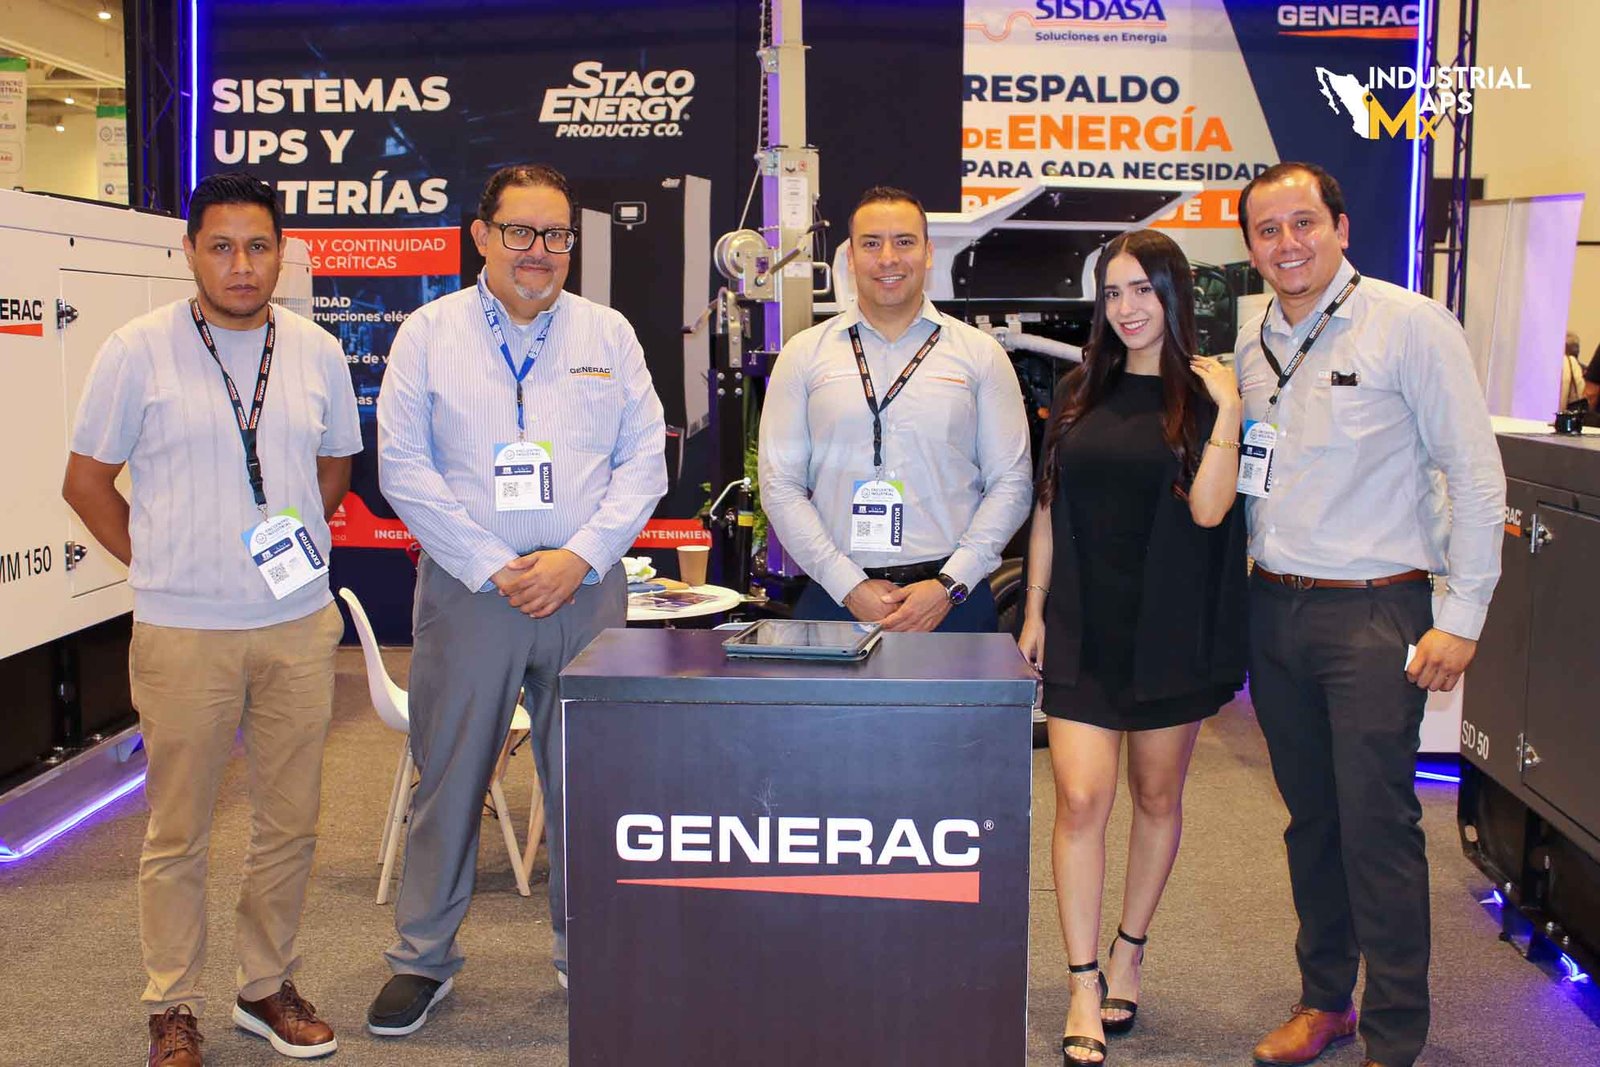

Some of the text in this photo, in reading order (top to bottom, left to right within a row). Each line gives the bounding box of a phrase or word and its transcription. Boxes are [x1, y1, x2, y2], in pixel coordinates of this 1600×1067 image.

[1277, 4, 1420, 26] GENERAC
[1035, 31, 1100, 42] Soluciones
[1103, 34, 1118, 42] en
[568, 61, 695, 98] STACO
[962, 74, 1180, 104] RESPALDO
[212, 76, 451, 114] SISTEMAS
[538, 88, 694, 122] ENERGY
[555, 123, 683, 138] PRODUCTS CO.
[962, 106, 1234, 151] DE ENERGÍA
[214, 129, 354, 164] UPS Y
[961, 160, 1033, 178] PARA
[1041, 160, 1115, 179] CADA
[276, 170, 449, 214] TERÍAS
[317, 240, 329, 251] Y
[331, 238, 447, 252] CONTINUIDAD
[325, 254, 398, 270] CRÍTICAS
[0, 299, 42, 320] ERAC
[362, 353, 379, 364] de
[569, 366, 611, 375] GENERAC
[374, 529, 413, 540] INGEN
[25, 546, 52, 576] 150
[1462, 720, 1490, 760] SD 50
[616, 813, 980, 867] GENERAC
